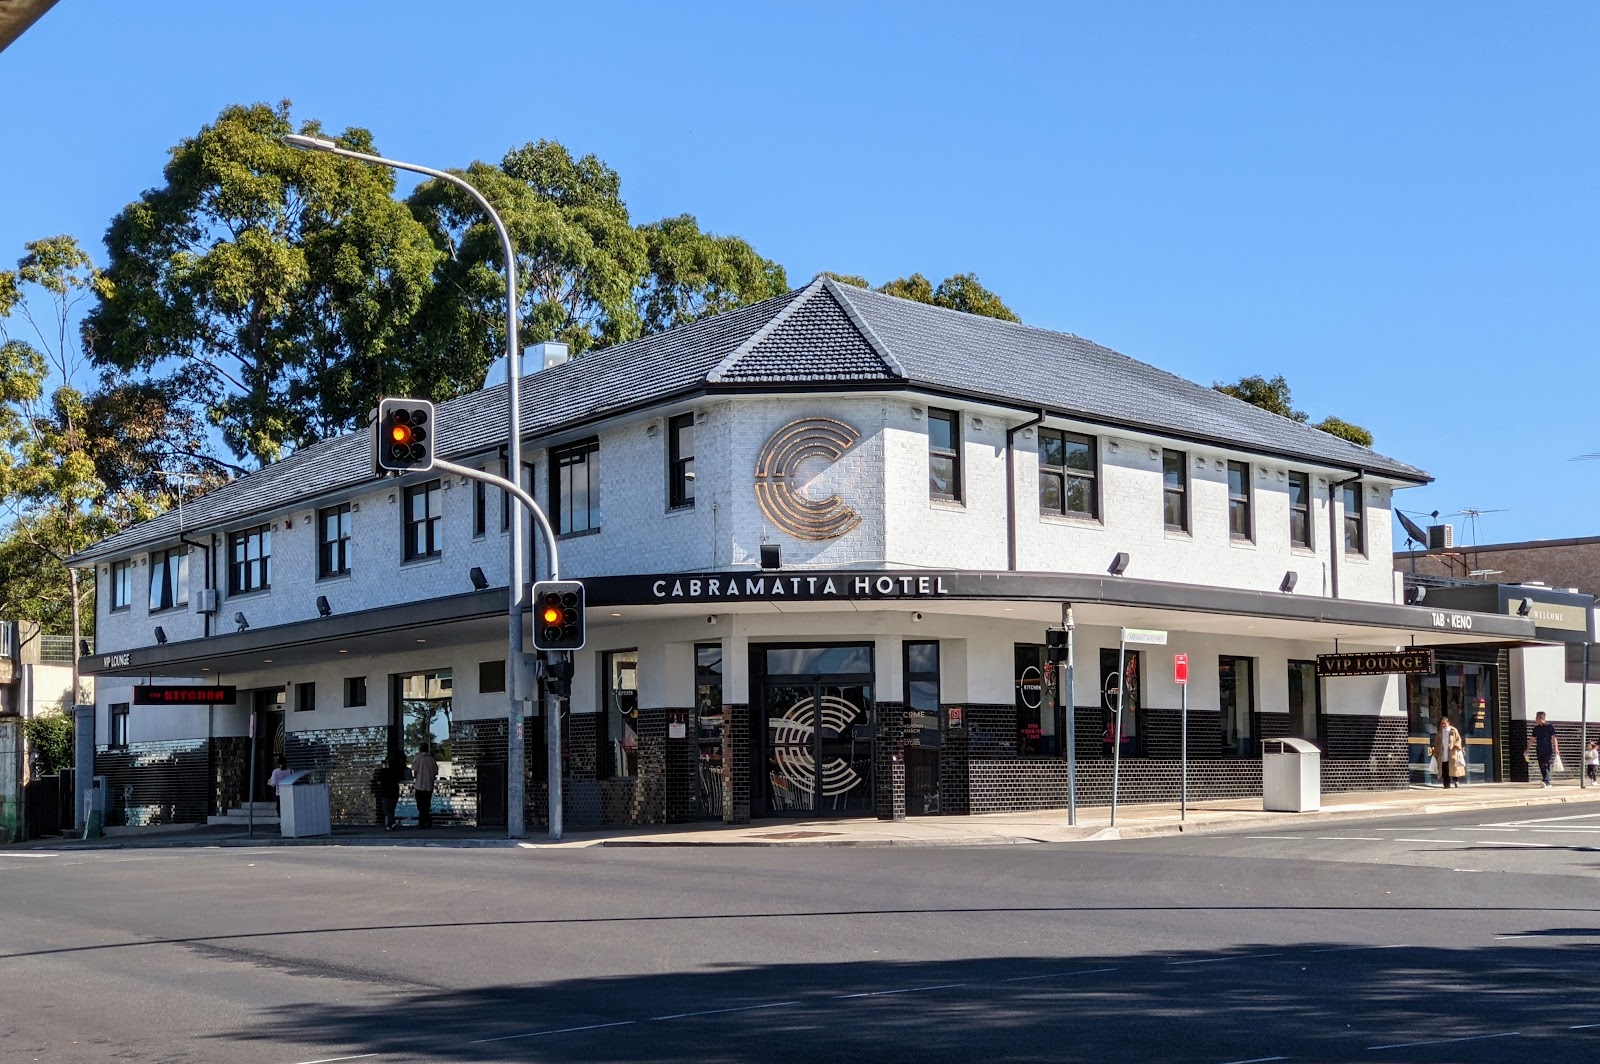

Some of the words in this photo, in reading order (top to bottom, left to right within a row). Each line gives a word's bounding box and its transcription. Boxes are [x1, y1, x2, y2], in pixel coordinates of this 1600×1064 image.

[652, 577, 837, 597] CABRAMATTA
[855, 576, 949, 594] HOTEL
[1431, 613, 1444, 627] TAB
[1451, 615, 1473, 629] KENO
[1534, 610, 1563, 621] WELCOME
[103, 657, 111, 668] VIP
[111, 654, 130, 667] LOUNGE
[1325, 659, 1351, 671] VIP
[1357, 656, 1423, 670] LOUNGE
[165, 691, 224, 701] KITCHEN
